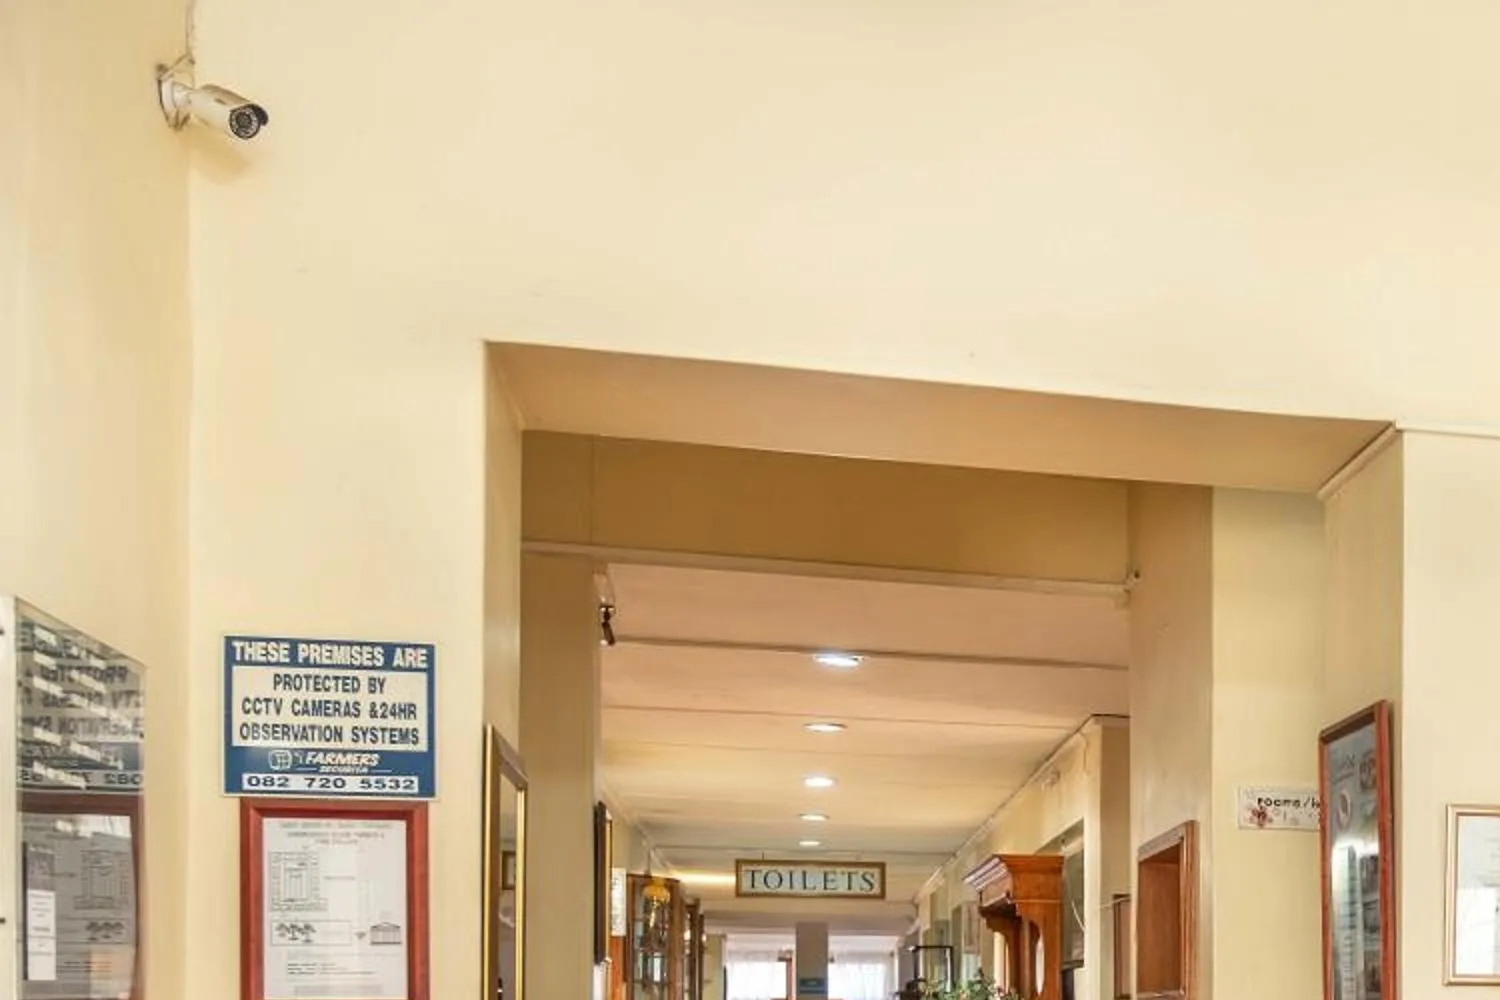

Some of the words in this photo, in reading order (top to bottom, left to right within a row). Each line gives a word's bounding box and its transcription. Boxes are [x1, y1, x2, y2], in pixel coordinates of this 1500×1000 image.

[232, 641, 290, 663] THESE
[298, 643, 385, 667] PREMISES
[392, 647, 428, 669] ARE
[273, 673, 361, 693] PROTECTED
[368, 676, 387, 694] BY
[241, 697, 283, 716] CCTV
[291, 699, 361, 719] CAMERAS
[369, 701, 417, 720] &24HR
[240, 723, 343, 743] OBSERVATION
[351, 726, 420, 745] SYSTEMS
[305, 751, 381, 767] FARMERS
[247, 776, 290, 788] 082
[304, 777, 347, 789] 720
[360, 778, 416, 790] 5532
[744, 869, 876, 892] TOILETS
